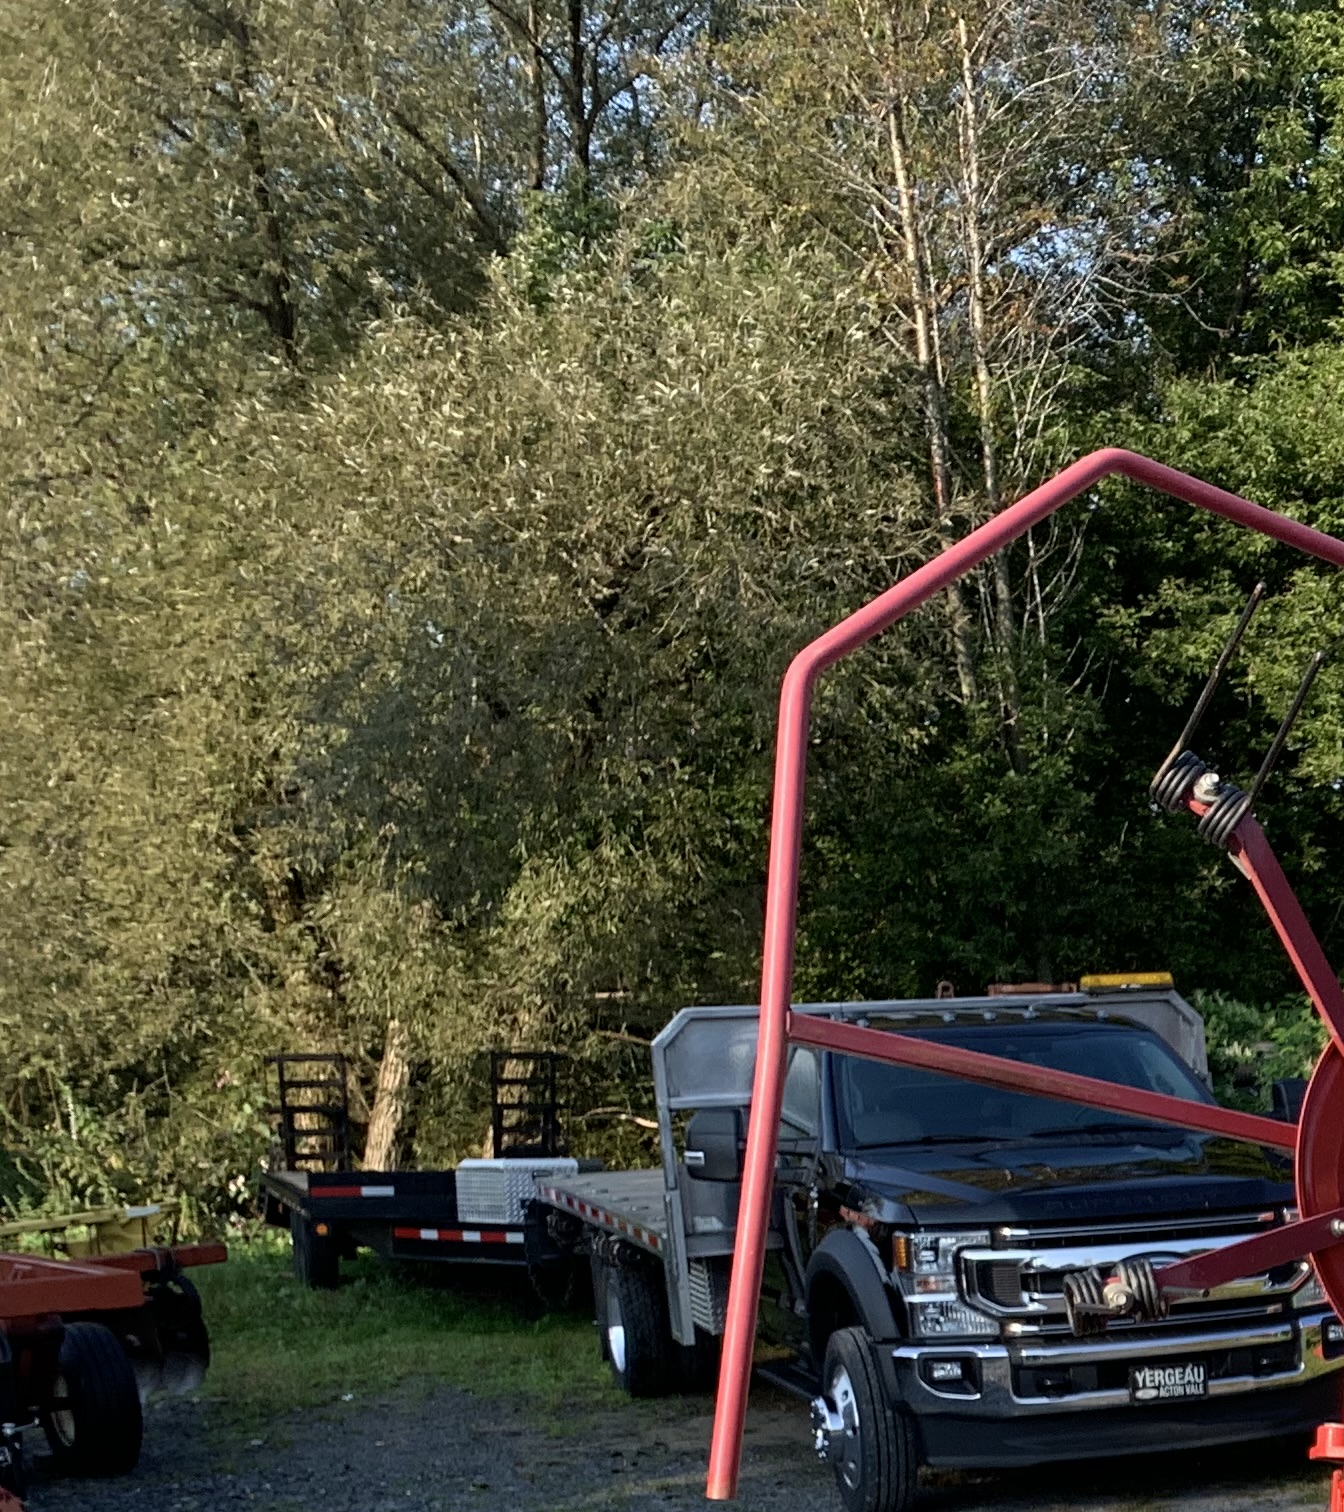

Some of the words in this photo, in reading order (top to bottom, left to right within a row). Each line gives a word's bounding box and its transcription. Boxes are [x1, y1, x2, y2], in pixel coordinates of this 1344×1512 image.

[1135, 1365, 1204, 1388] YERGEAU
[1159, 1385, 1185, 1397] ACTON
[1185, 1383, 1204, 1395] VALE
